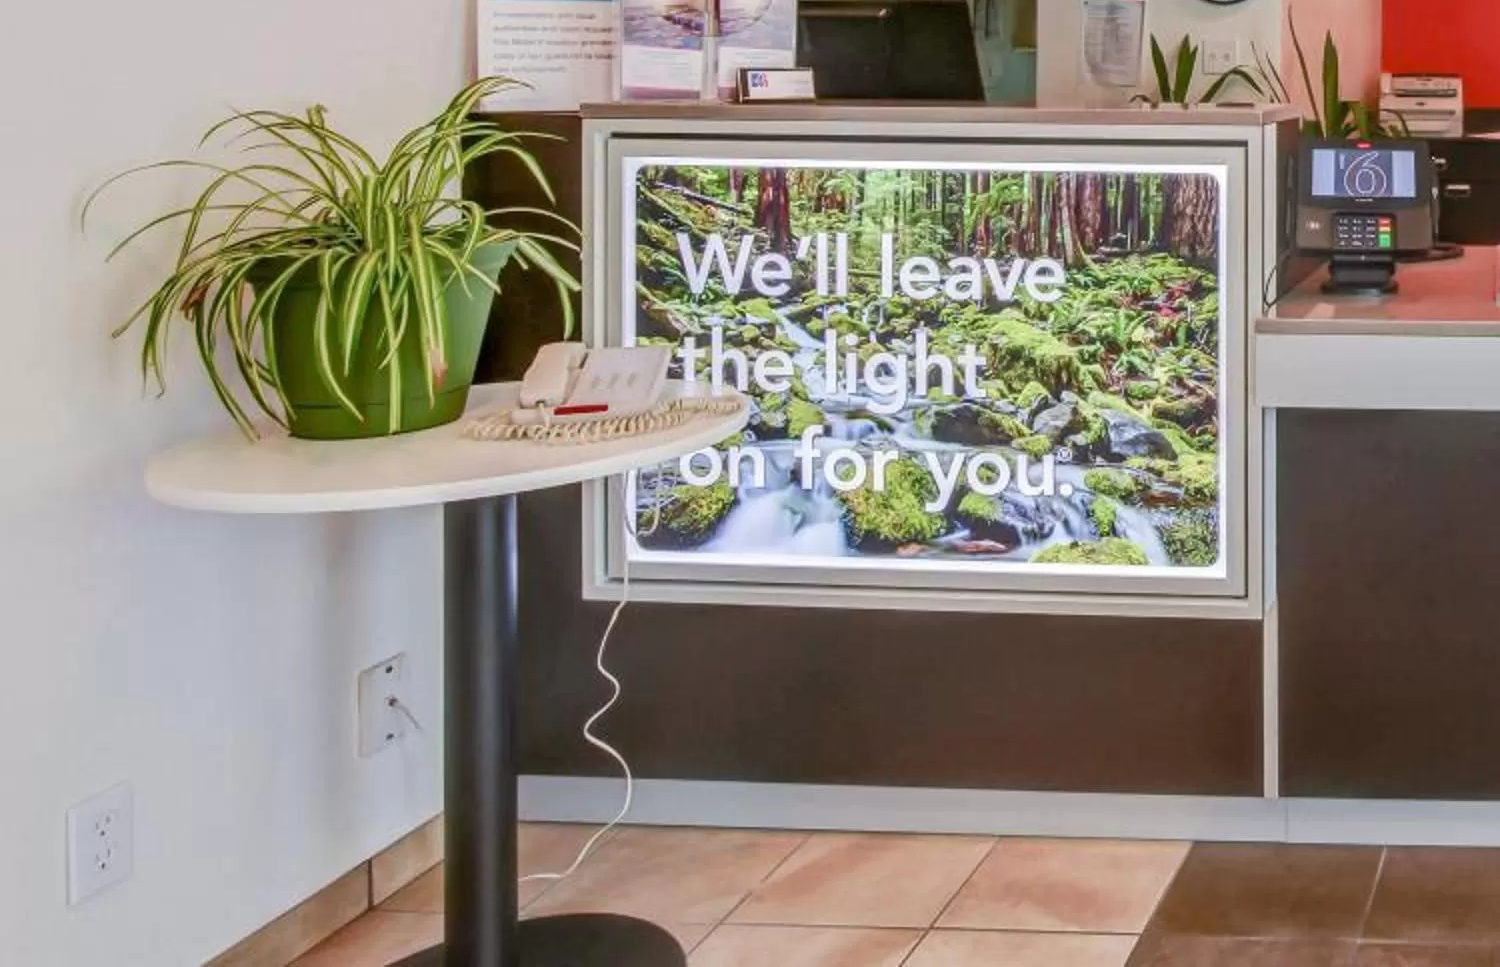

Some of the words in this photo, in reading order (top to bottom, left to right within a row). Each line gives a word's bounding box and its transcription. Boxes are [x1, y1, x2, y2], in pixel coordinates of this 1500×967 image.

[1344, 150, 1387, 197] 6
[677, 232, 849, 297] We'll
[880, 232, 1066, 302] leave
[677, 327, 794, 395] the
[824, 328, 987, 414] light
[679, 444, 765, 488] on
[794, 424, 898, 492] for
[924, 448, 1073, 513] you.
